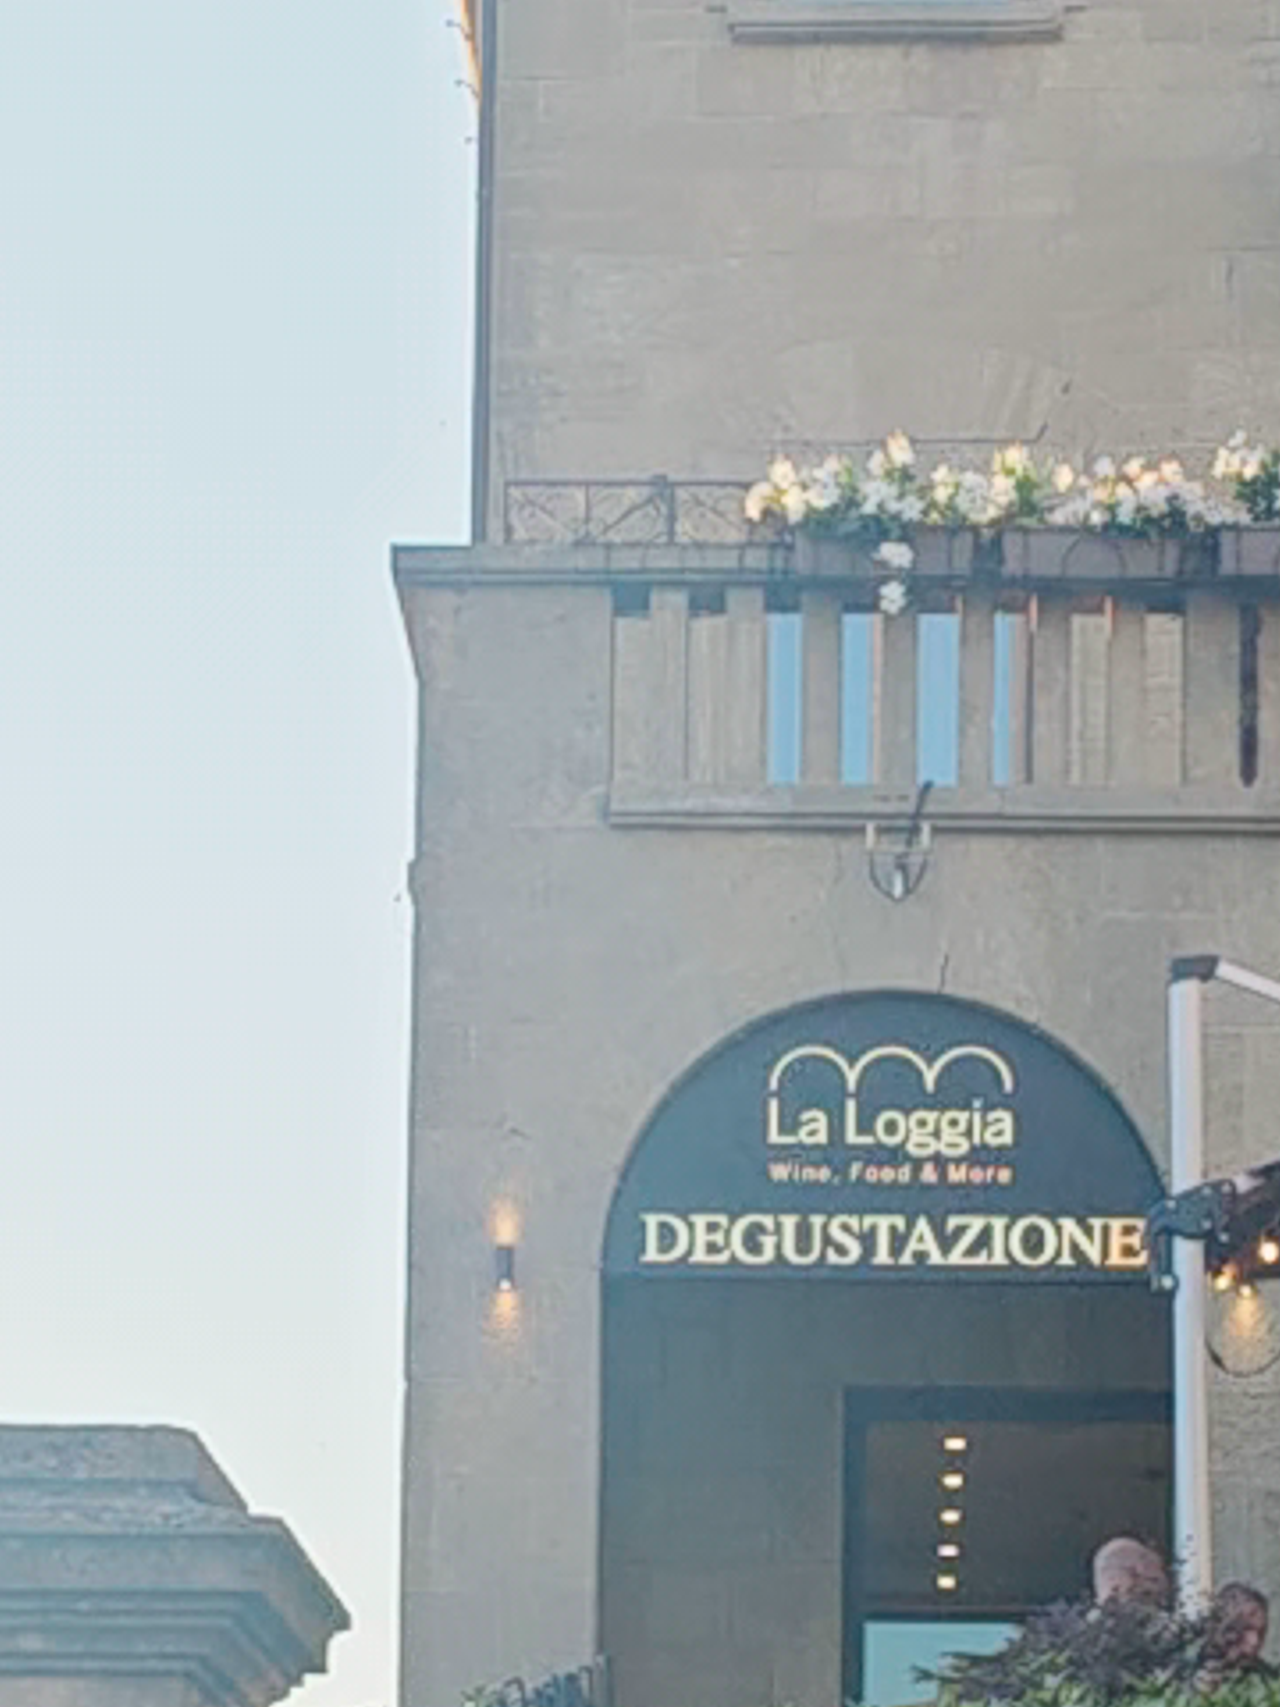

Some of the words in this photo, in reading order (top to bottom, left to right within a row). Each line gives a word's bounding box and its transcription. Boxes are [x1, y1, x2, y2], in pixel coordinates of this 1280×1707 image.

[767, 1097, 828, 1144] La
[845, 1097, 1014, 1157] Loggia
[769, 1162, 841, 1185] Wine,
[850, 1162, 912, 1184] Food
[920, 1163, 939, 1184] &
[947, 1163, 1013, 1185] More
[638, 1212, 1149, 1267] DEGUSTAZIONE
